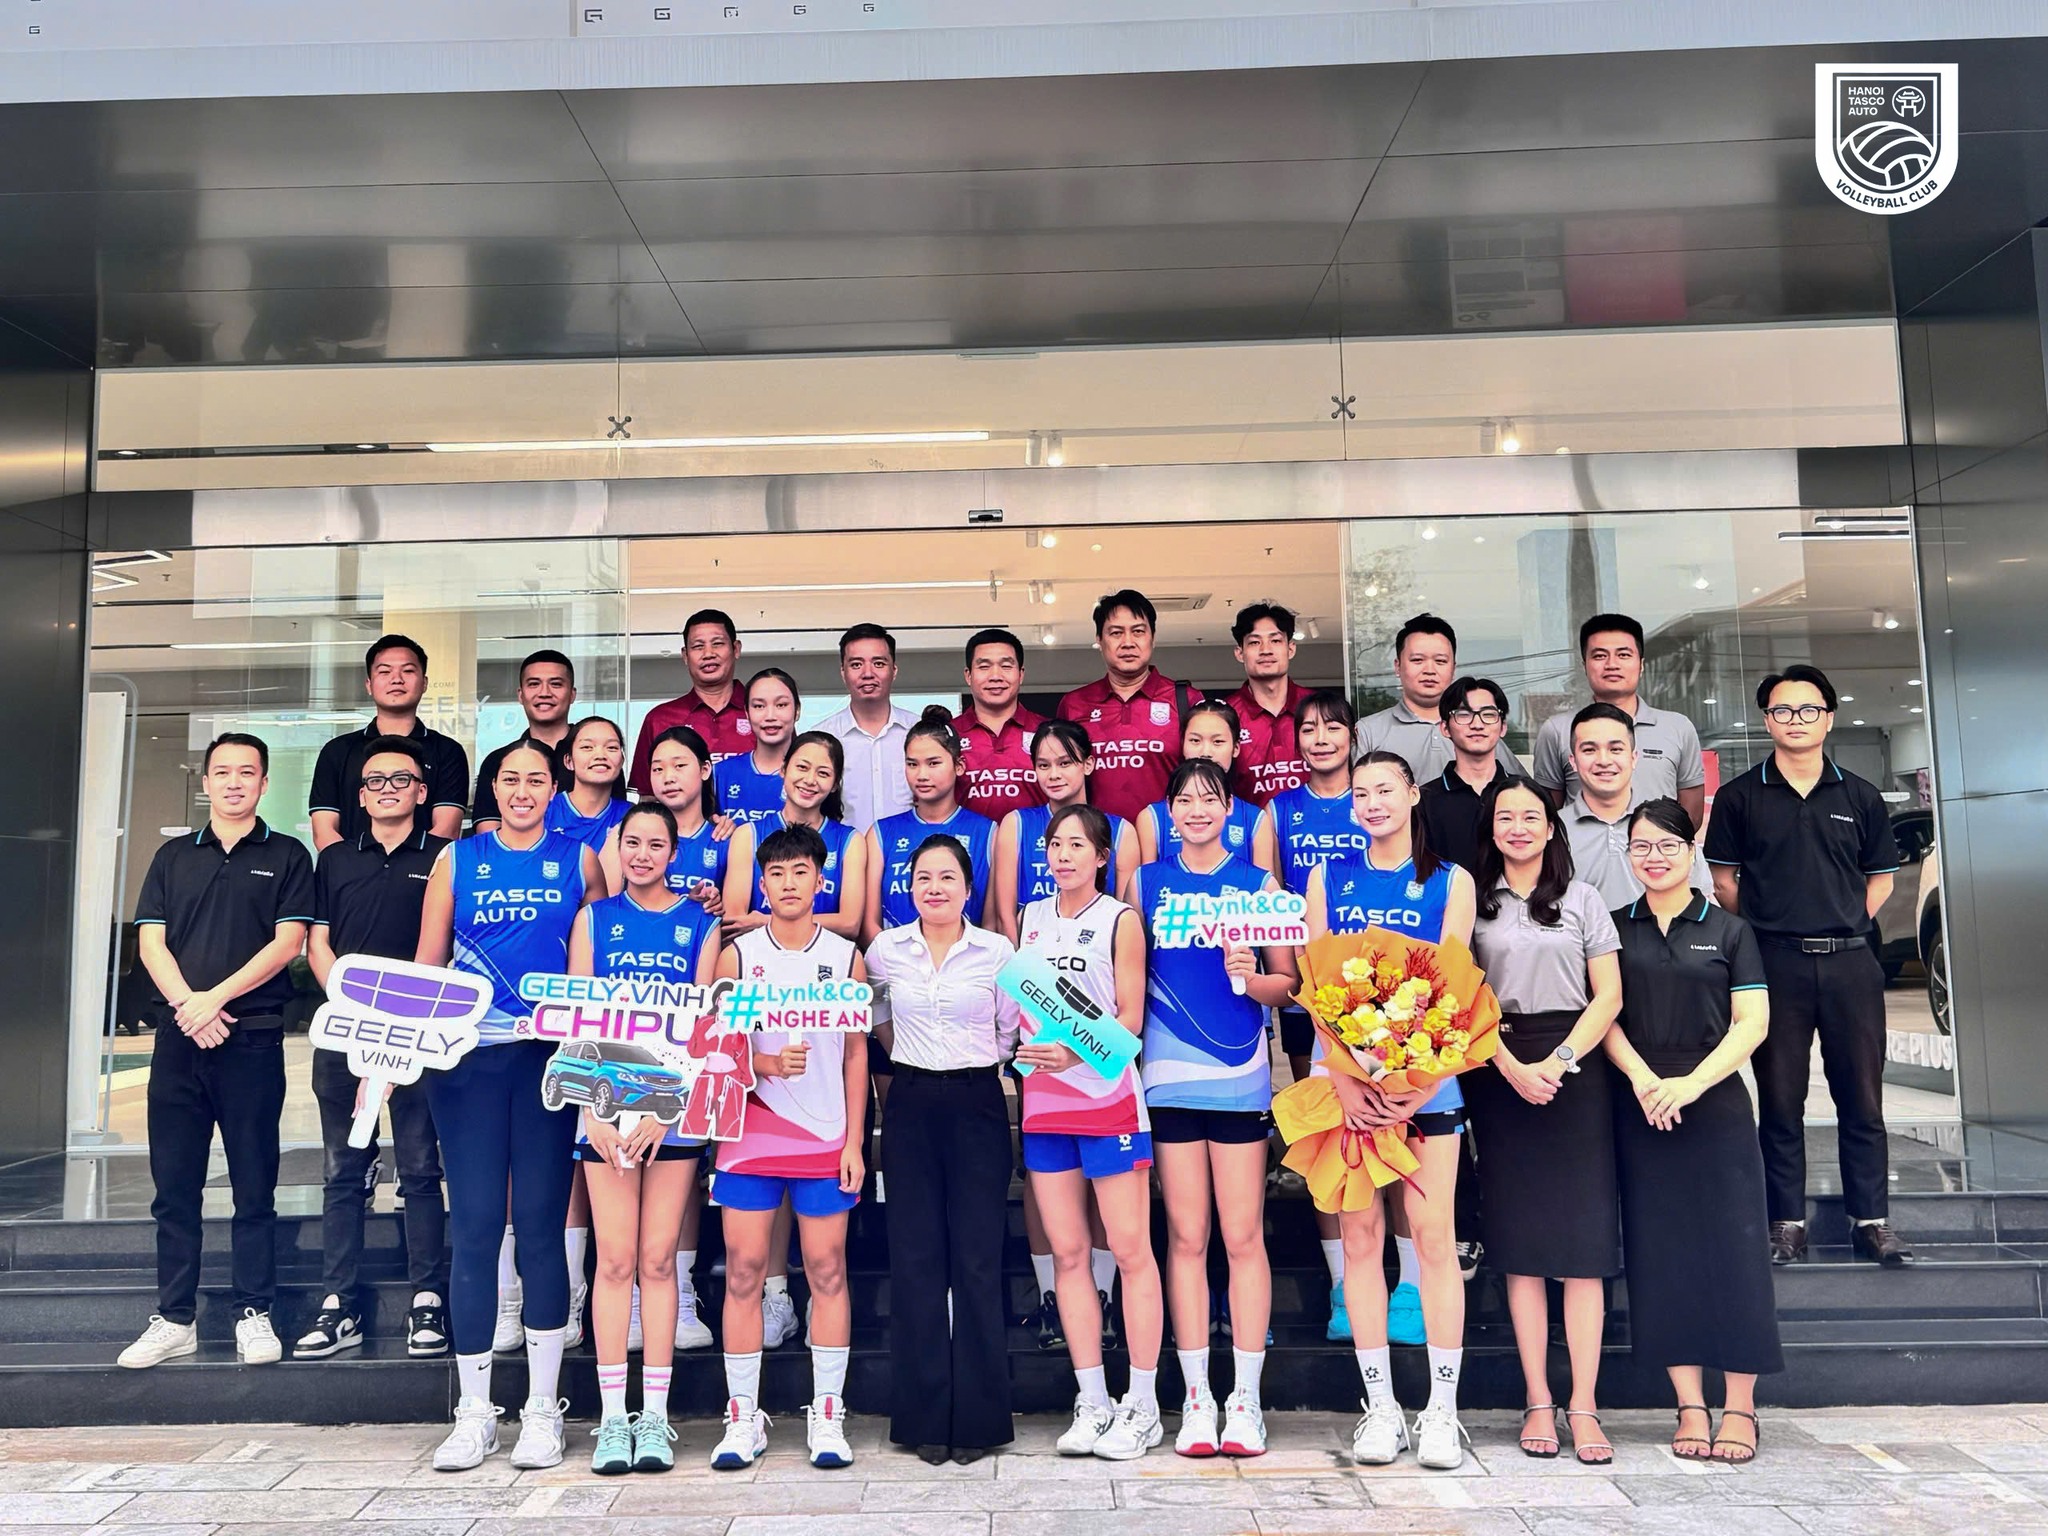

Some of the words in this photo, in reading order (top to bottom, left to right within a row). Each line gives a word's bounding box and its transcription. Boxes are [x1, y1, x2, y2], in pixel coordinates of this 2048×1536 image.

[420, 695, 490, 713] EELY
[1092, 740, 1164, 754] TASCO
[1095, 755, 1144, 770] AUTO
[965, 769, 1038, 783] TASCO
[1253, 776, 1301, 794] AUTO
[968, 784, 1020, 798] AUTO
[1289, 833, 1367, 850] TASCO
[473, 888, 562, 905] TASCO
[472, 906, 538, 925] AUTO
[1335, 905, 1422, 928] TASCO
[1201, 922, 1304, 942] Vietnam
[606, 951, 688, 972] TASCO
[523, 976, 623, 1002] GEELY
[631, 982, 705, 1009] VINH
[516, 1020, 531, 1035] &
[767, 1009, 830, 1028] NGHE
[836, 1009, 868, 1028] AN
[1020, 979, 1073, 1024] GEELY
[1072, 1021, 1112, 1062] VINH
[323, 1014, 465, 1056] GEELY
[361, 1049, 412, 1071] VINH
